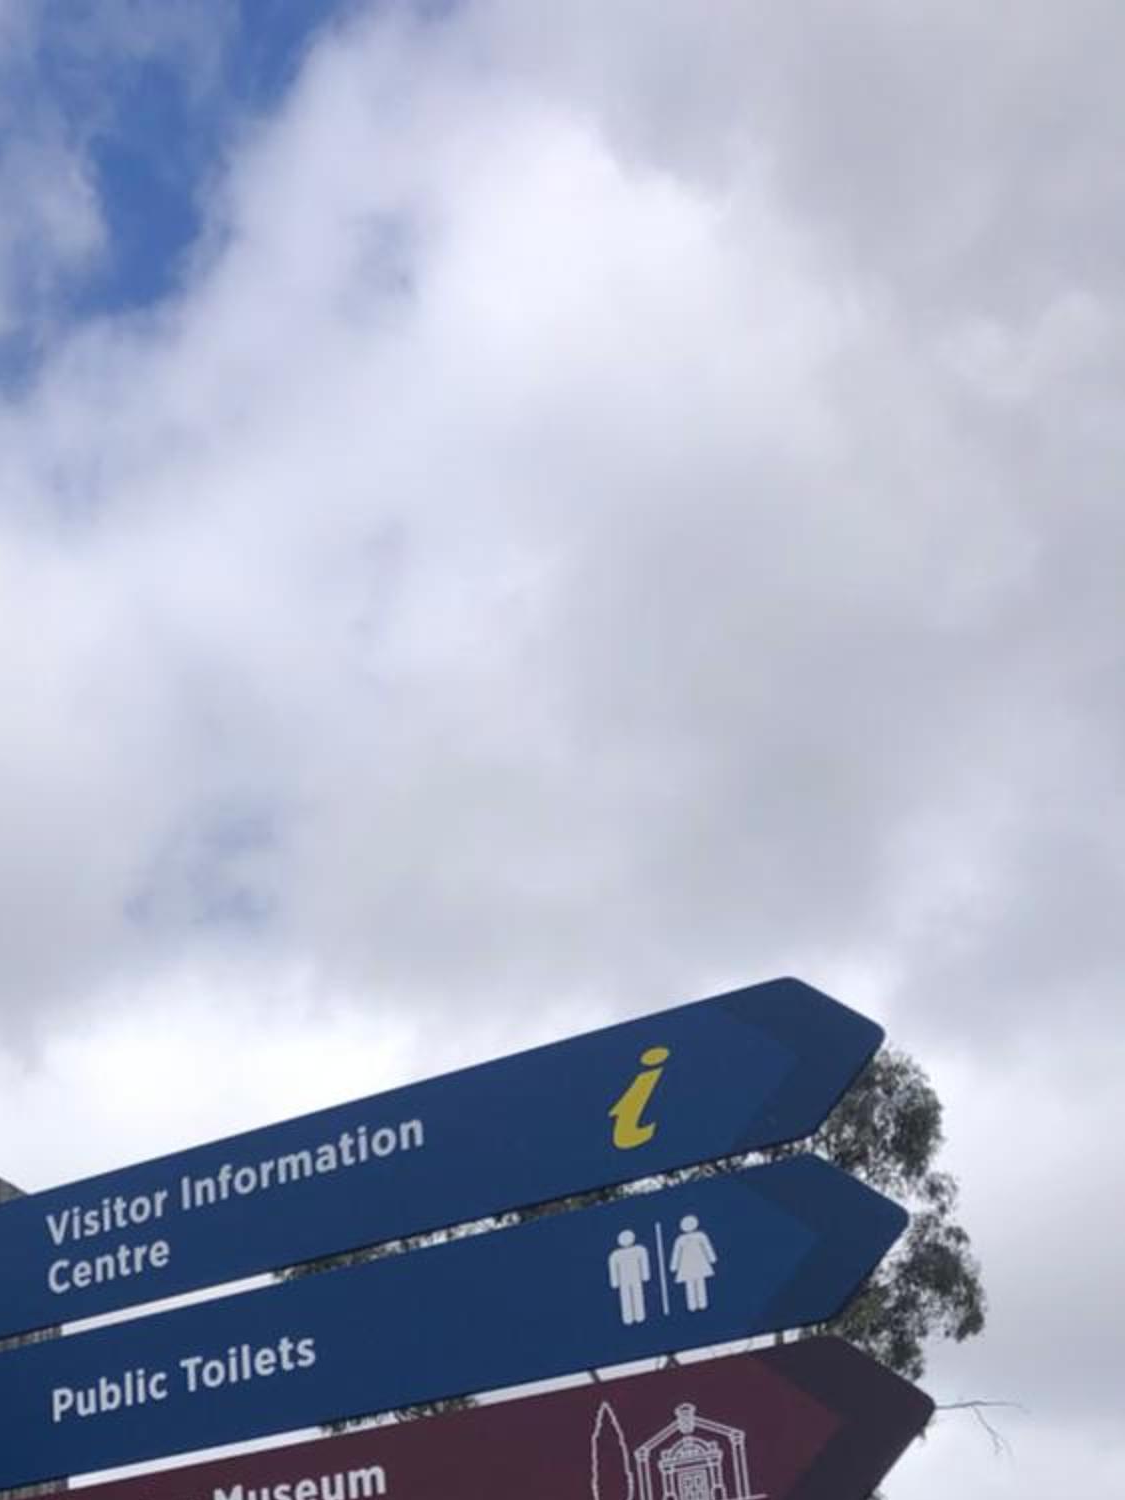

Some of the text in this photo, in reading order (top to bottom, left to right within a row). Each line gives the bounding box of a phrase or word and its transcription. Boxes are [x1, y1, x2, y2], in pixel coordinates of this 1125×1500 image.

[45, 1119, 424, 1246] Visitor Information
[48, 1239, 170, 1294] Centre
[52, 1336, 316, 1423] Public Toilets
